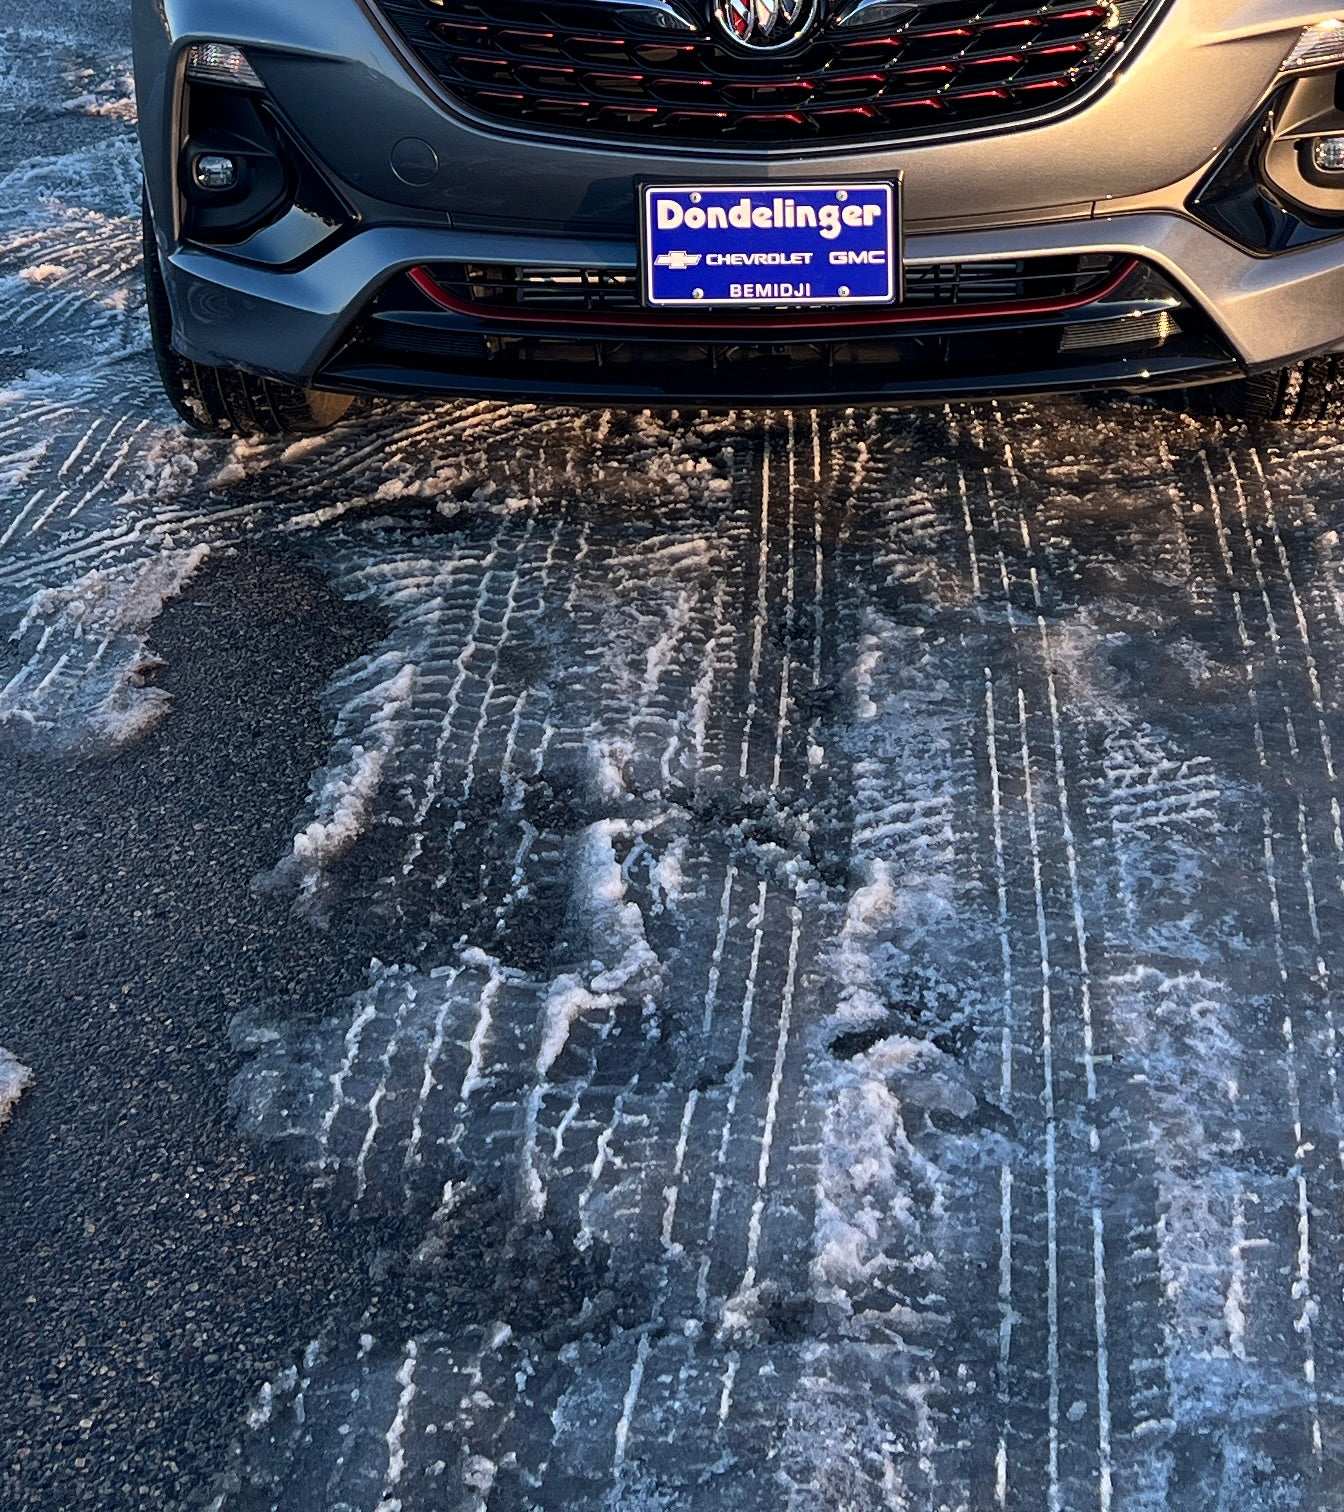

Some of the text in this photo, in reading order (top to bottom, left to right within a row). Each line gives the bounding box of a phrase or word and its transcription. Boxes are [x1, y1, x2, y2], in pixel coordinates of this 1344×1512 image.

[656, 197, 881, 239] Dondelinger
[706, 250, 885, 265] CHEVROLET GMC
[729, 283, 811, 297] BEMIDJI
